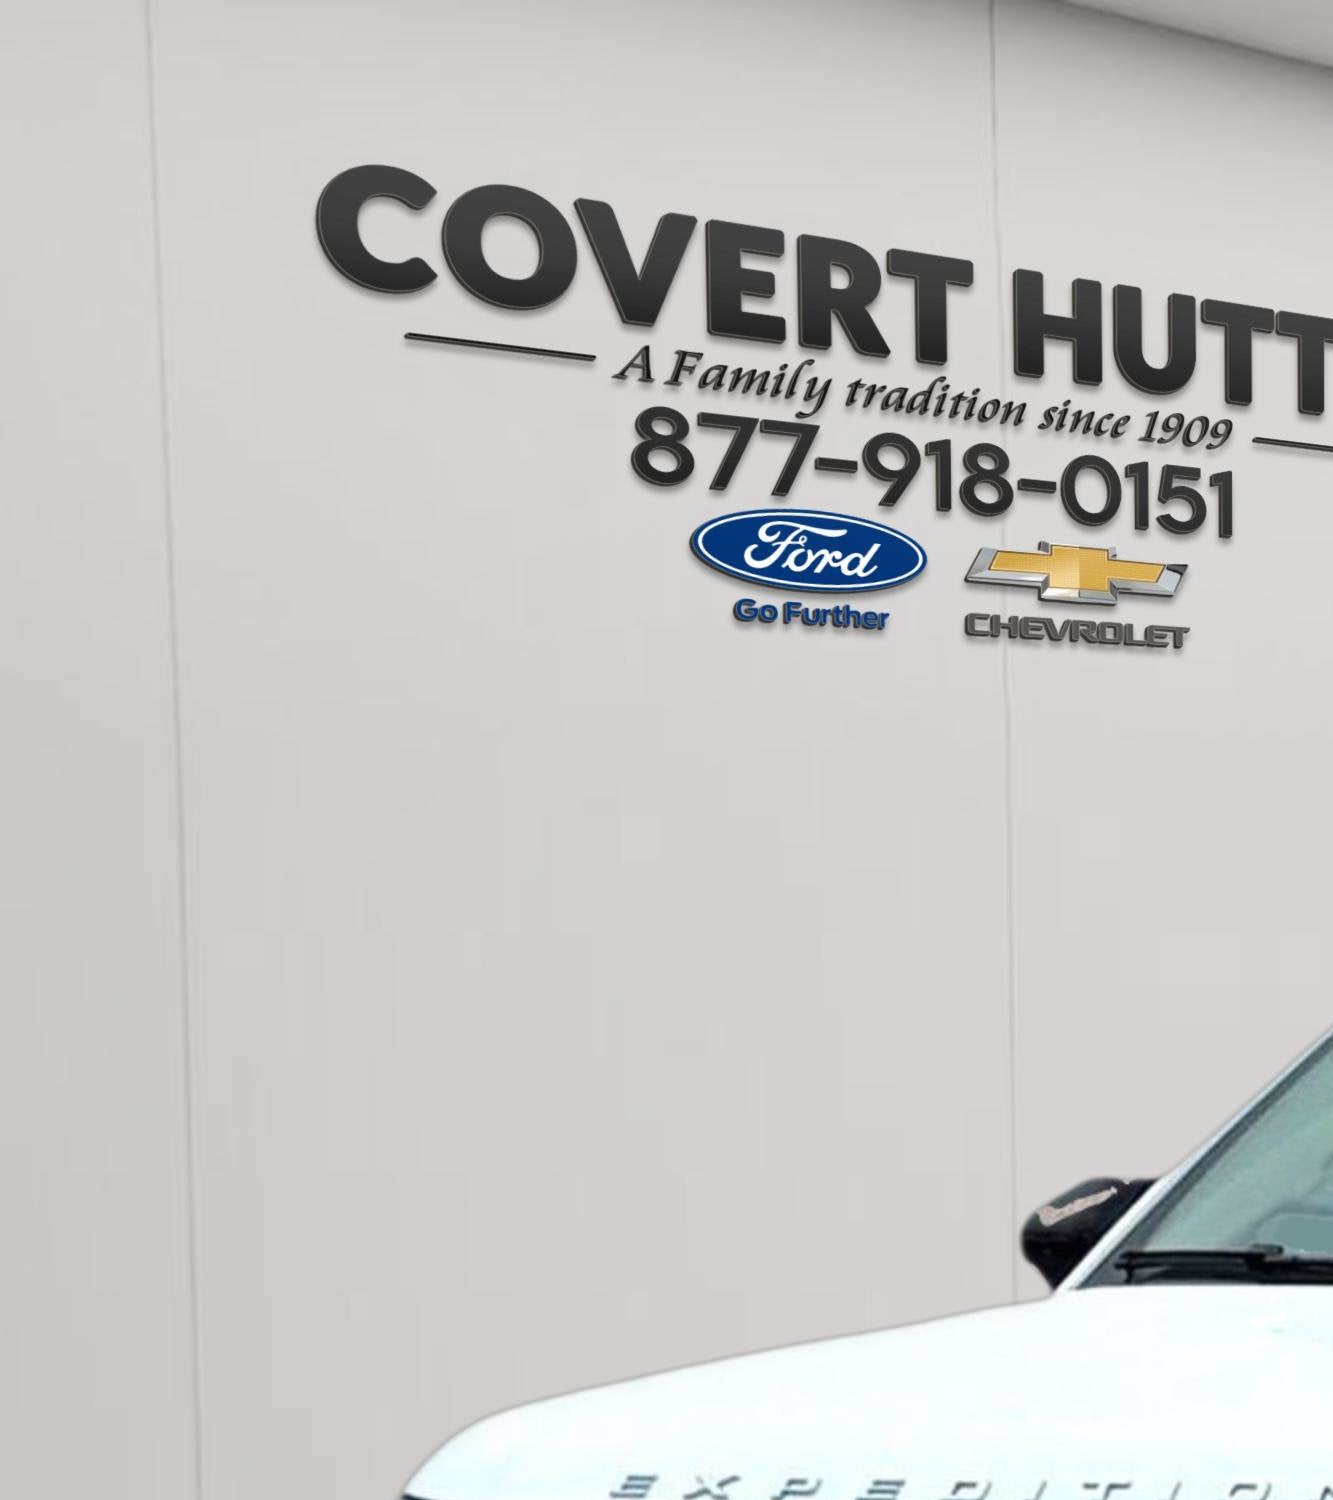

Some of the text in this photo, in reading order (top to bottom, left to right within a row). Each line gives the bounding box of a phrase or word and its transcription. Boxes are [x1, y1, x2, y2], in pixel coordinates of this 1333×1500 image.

[316, 163, 974, 366] COVERT
[612, 345, 1233, 449] A Family tradition since 1909
[631, 405, 1233, 539] 877-918-0151
[743, 519, 881, 578] Ford
[735, 598, 890, 631] Go Further
[963, 612, 1191, 649] CHEVROLET
